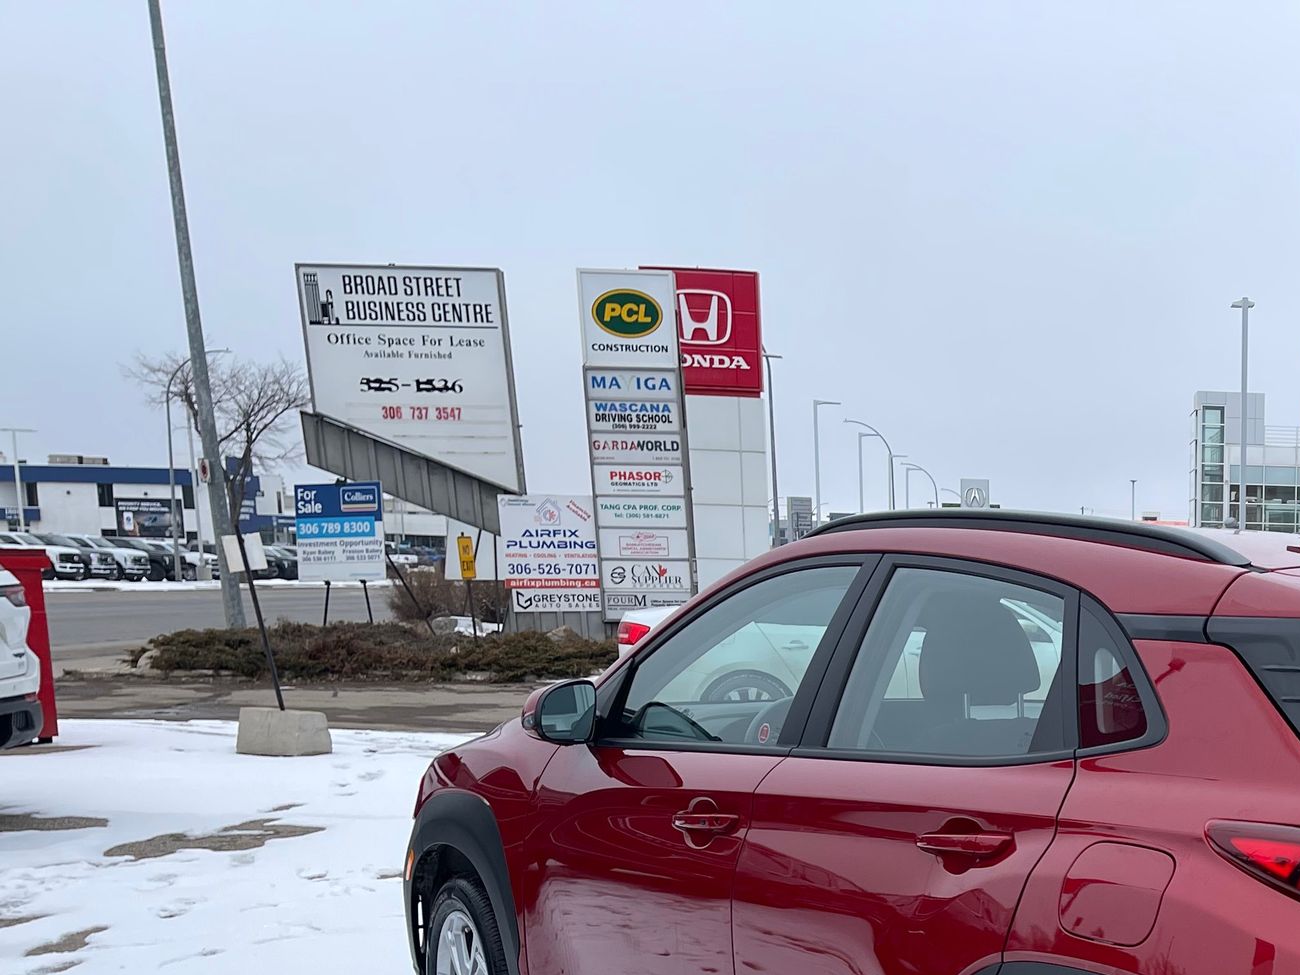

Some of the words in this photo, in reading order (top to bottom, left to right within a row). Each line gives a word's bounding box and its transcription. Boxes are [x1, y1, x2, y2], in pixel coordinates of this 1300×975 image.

[342, 275, 398, 296] BROAD
[403, 276, 462, 297] STREET
[345, 301, 427, 322] BUSINESS
[431, 303, 494, 323] CENTRE
[604, 303, 652, 323] PCL
[327, 333, 372, 345] Office
[378, 334, 415, 348] Space
[422, 335, 443, 346] For
[450, 335, 486, 347] Lease
[591, 343, 670, 353] CONSTRUCTION
[363, 350, 404, 359] Available
[408, 350, 452, 360] Furnished
[680, 354, 750, 370] ONDA
[382, 406, 402, 420] 306
[410, 406, 429, 420] 737
[435, 407, 462, 420] 3547
[594, 402, 671, 413] WASCANA
[595, 413, 633, 423] DRIVING
[635, 414, 673, 424] SCHOOL
[609, 471, 662, 481] PHASOR
[297, 488, 317, 500] For
[344, 491, 374, 502] Colliers
[297, 501, 322, 514] Sale
[299, 524, 319, 535] 306
[321, 522, 341, 534] 789
[343, 521, 371, 533] 8300
[521, 529, 579, 538] AIRFIX
[339, 539, 383, 549] Opportunity
[506, 540, 596, 549] PLUMBING
[508, 563, 597, 575] 306-526-7071
[510, 579, 596, 588] airfixplumbing.ca
[533, 594, 600, 602] GREYSTONE
